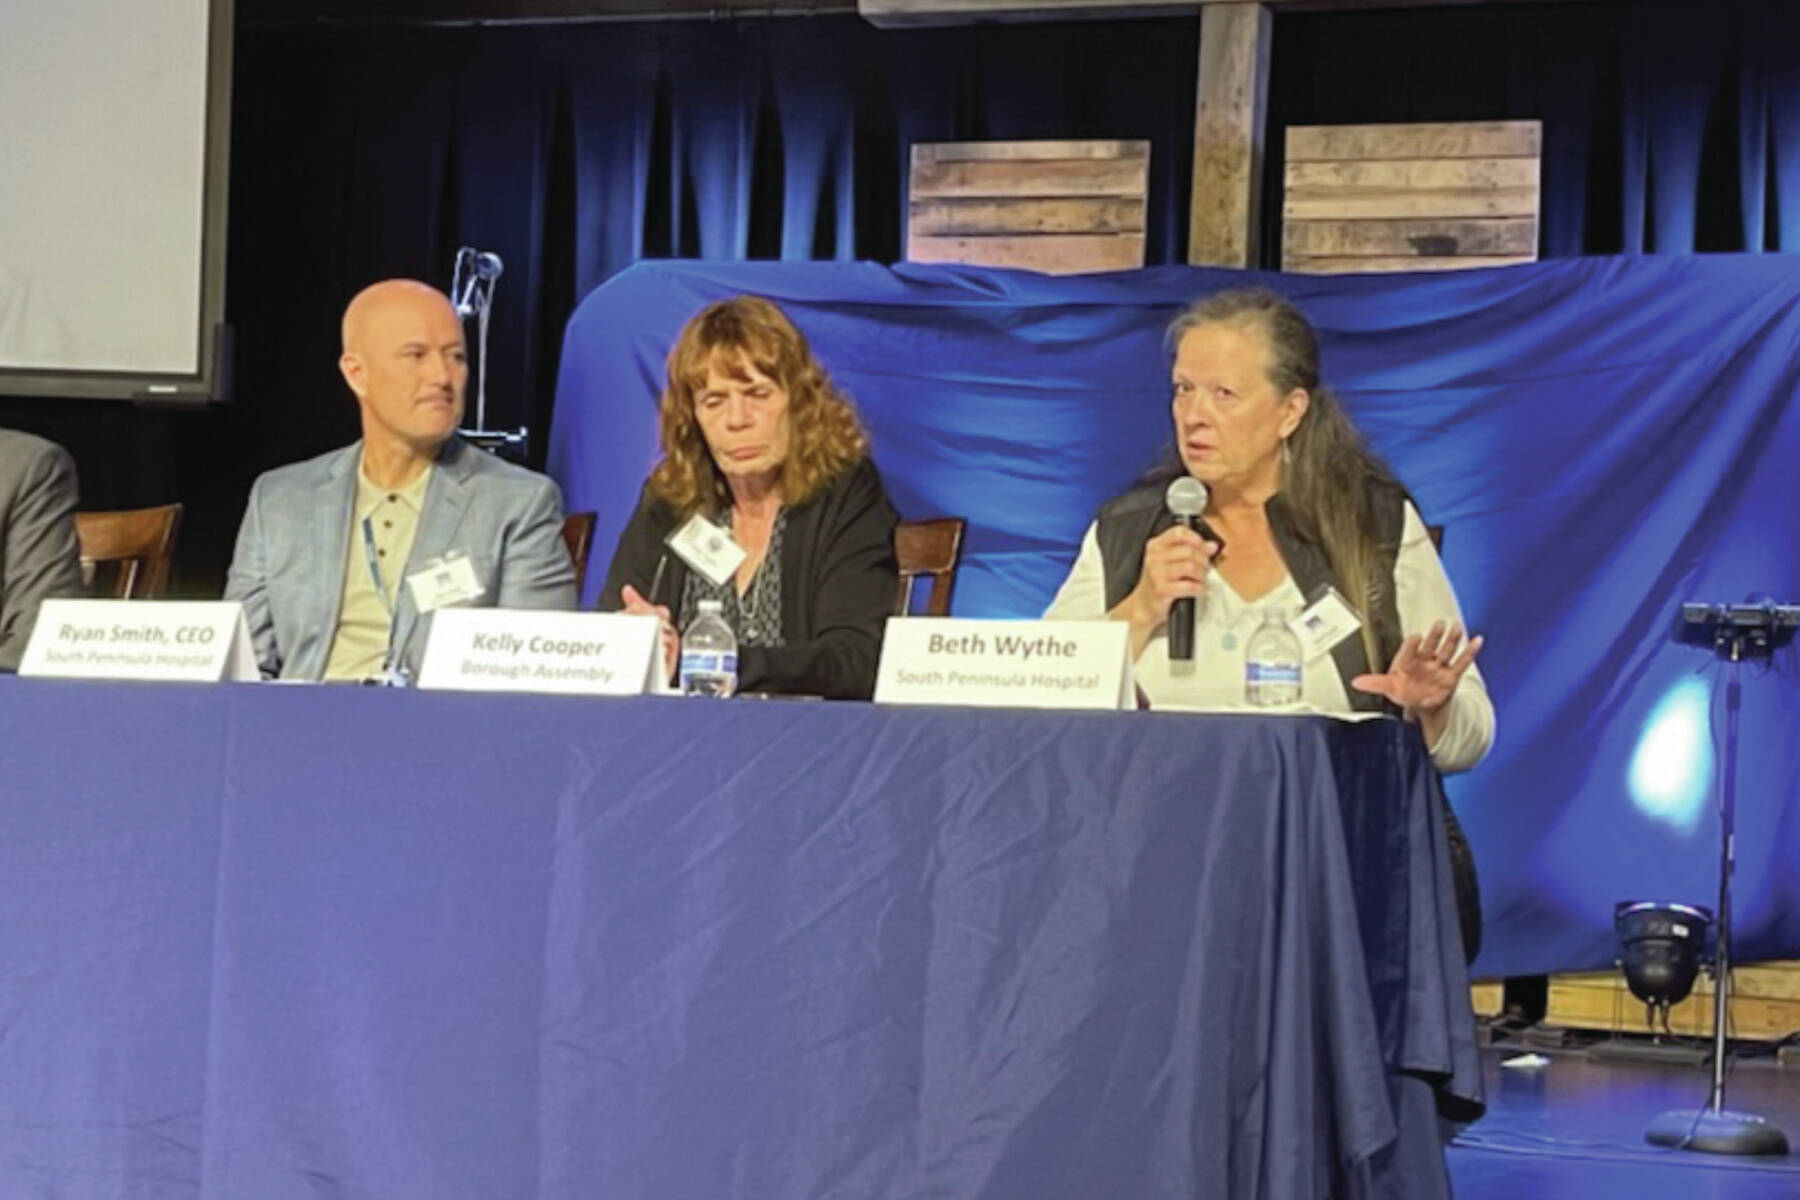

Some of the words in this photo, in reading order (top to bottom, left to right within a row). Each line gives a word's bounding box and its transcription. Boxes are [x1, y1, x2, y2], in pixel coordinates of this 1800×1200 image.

[59, 624, 105, 643] Ryan
[175, 627, 215, 644] CEO
[472, 632, 524, 655] Kelly
[529, 635, 606, 657] Cooper
[928, 633, 986, 655] Beth
[994, 635, 1077, 660] Wythe
[460, 660, 530, 679] Borough
[533, 664, 615, 683] Assembly
[896, 669, 943, 684] South
[948, 671, 1026, 687] Peninsula
[1031, 673, 1100, 690] Hospital
